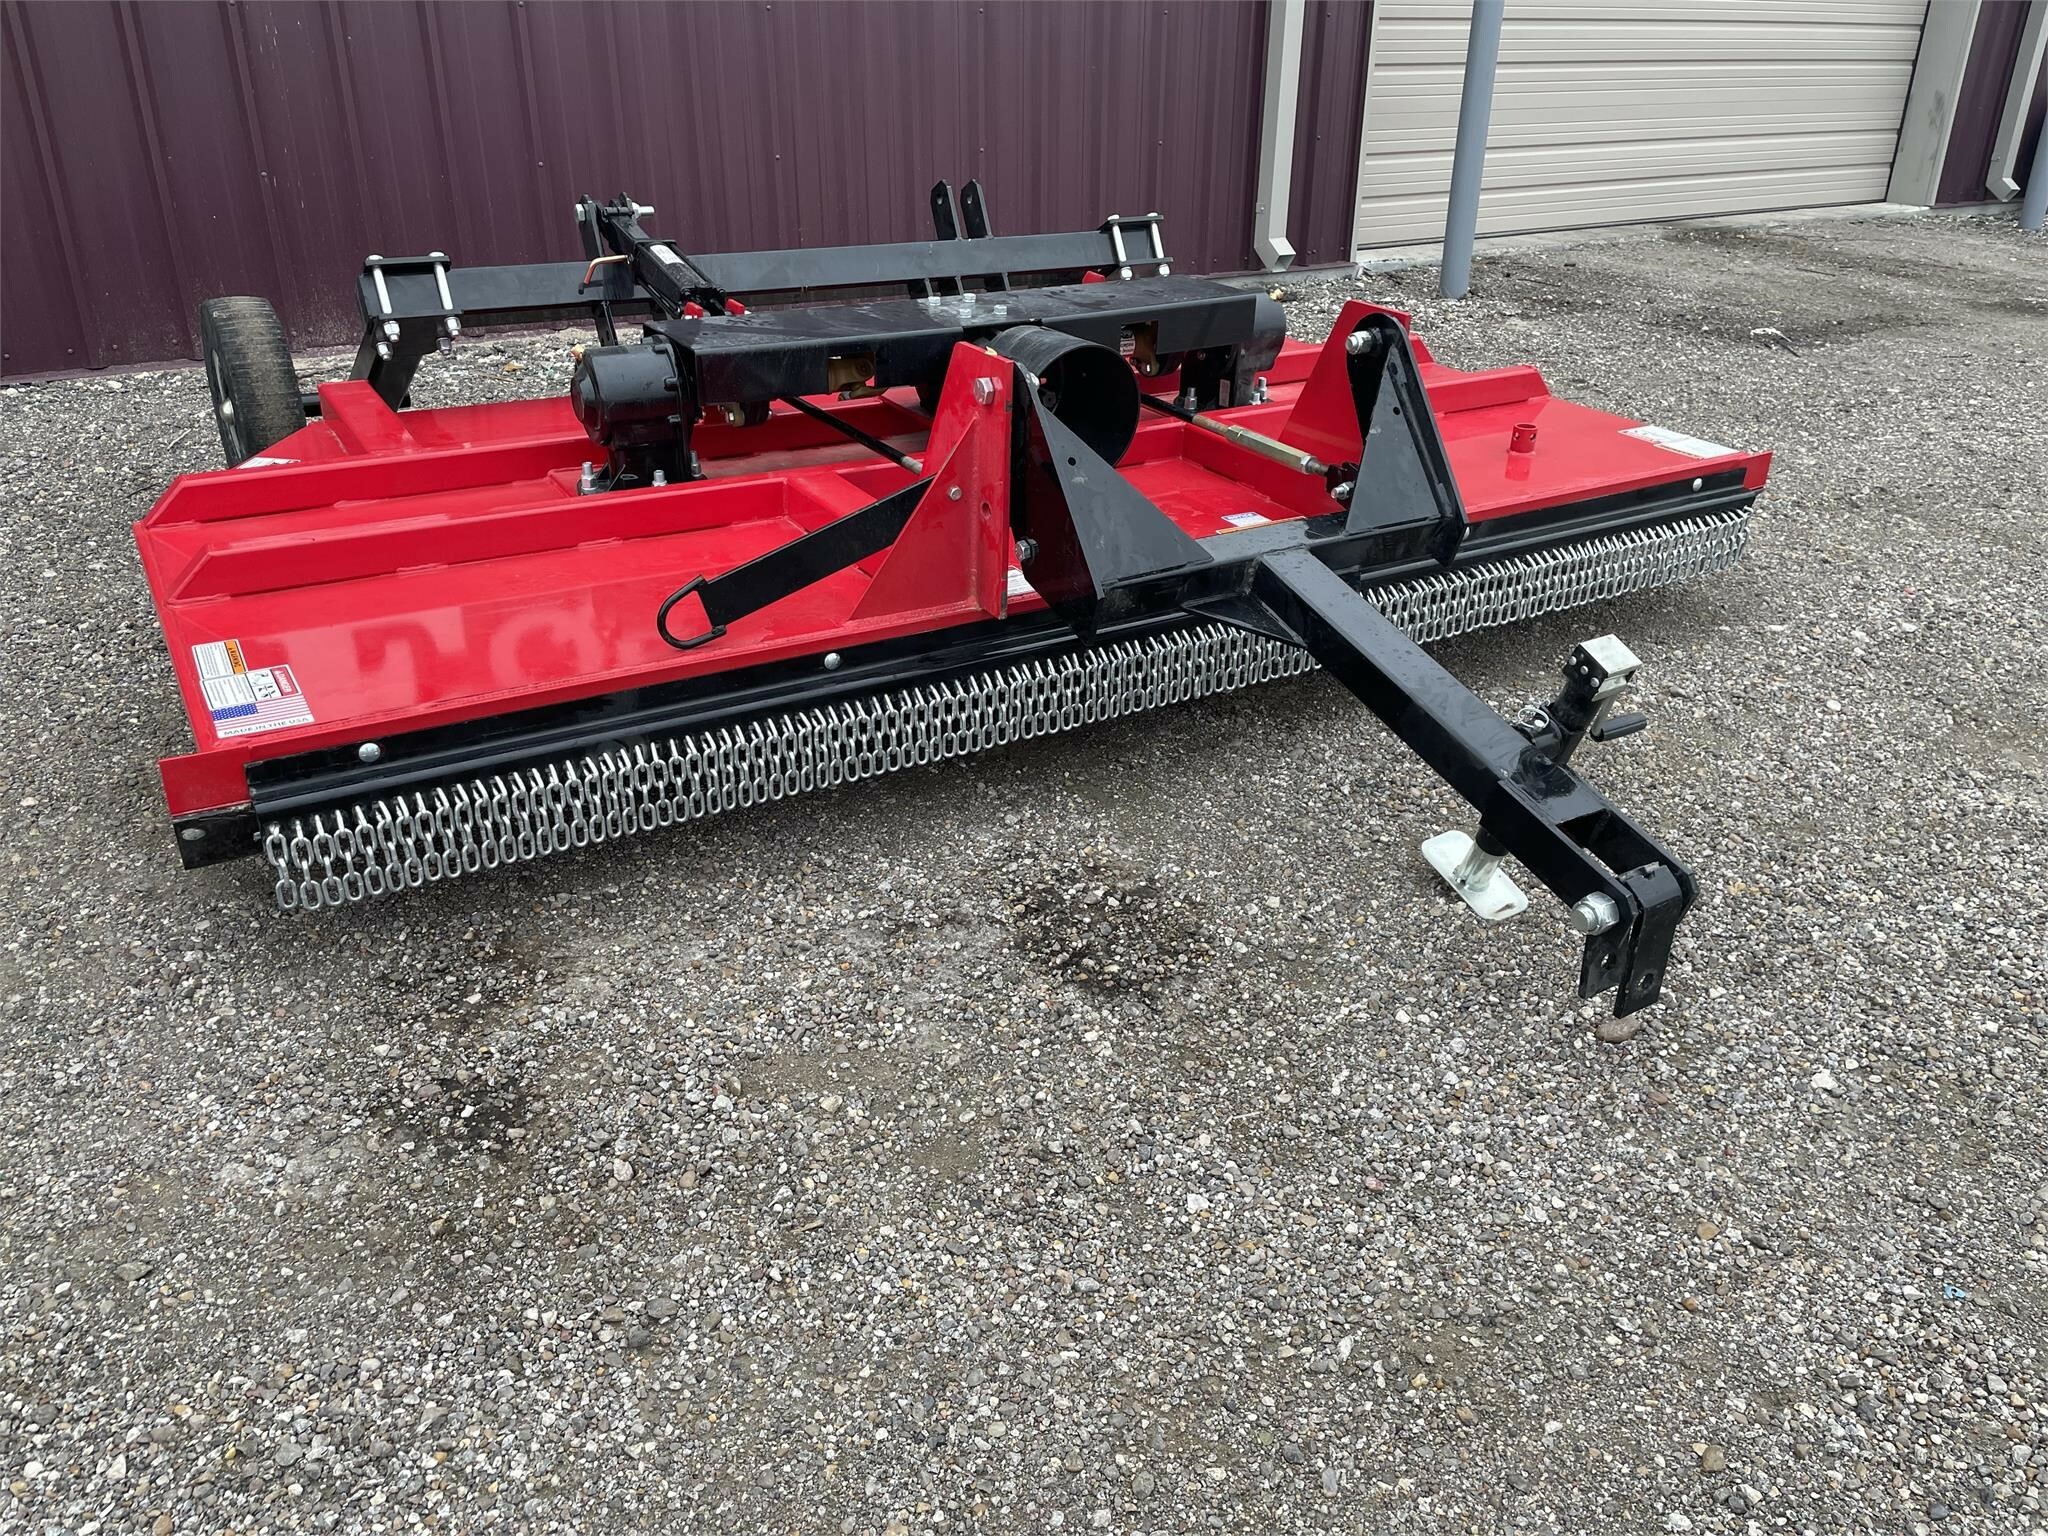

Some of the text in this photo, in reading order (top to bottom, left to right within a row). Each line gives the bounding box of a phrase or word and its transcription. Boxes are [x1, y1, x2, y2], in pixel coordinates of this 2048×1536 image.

[276, 673, 292, 693] DANGER
[224, 727, 253, 735] MADE
[267, 721, 286, 730] THE
